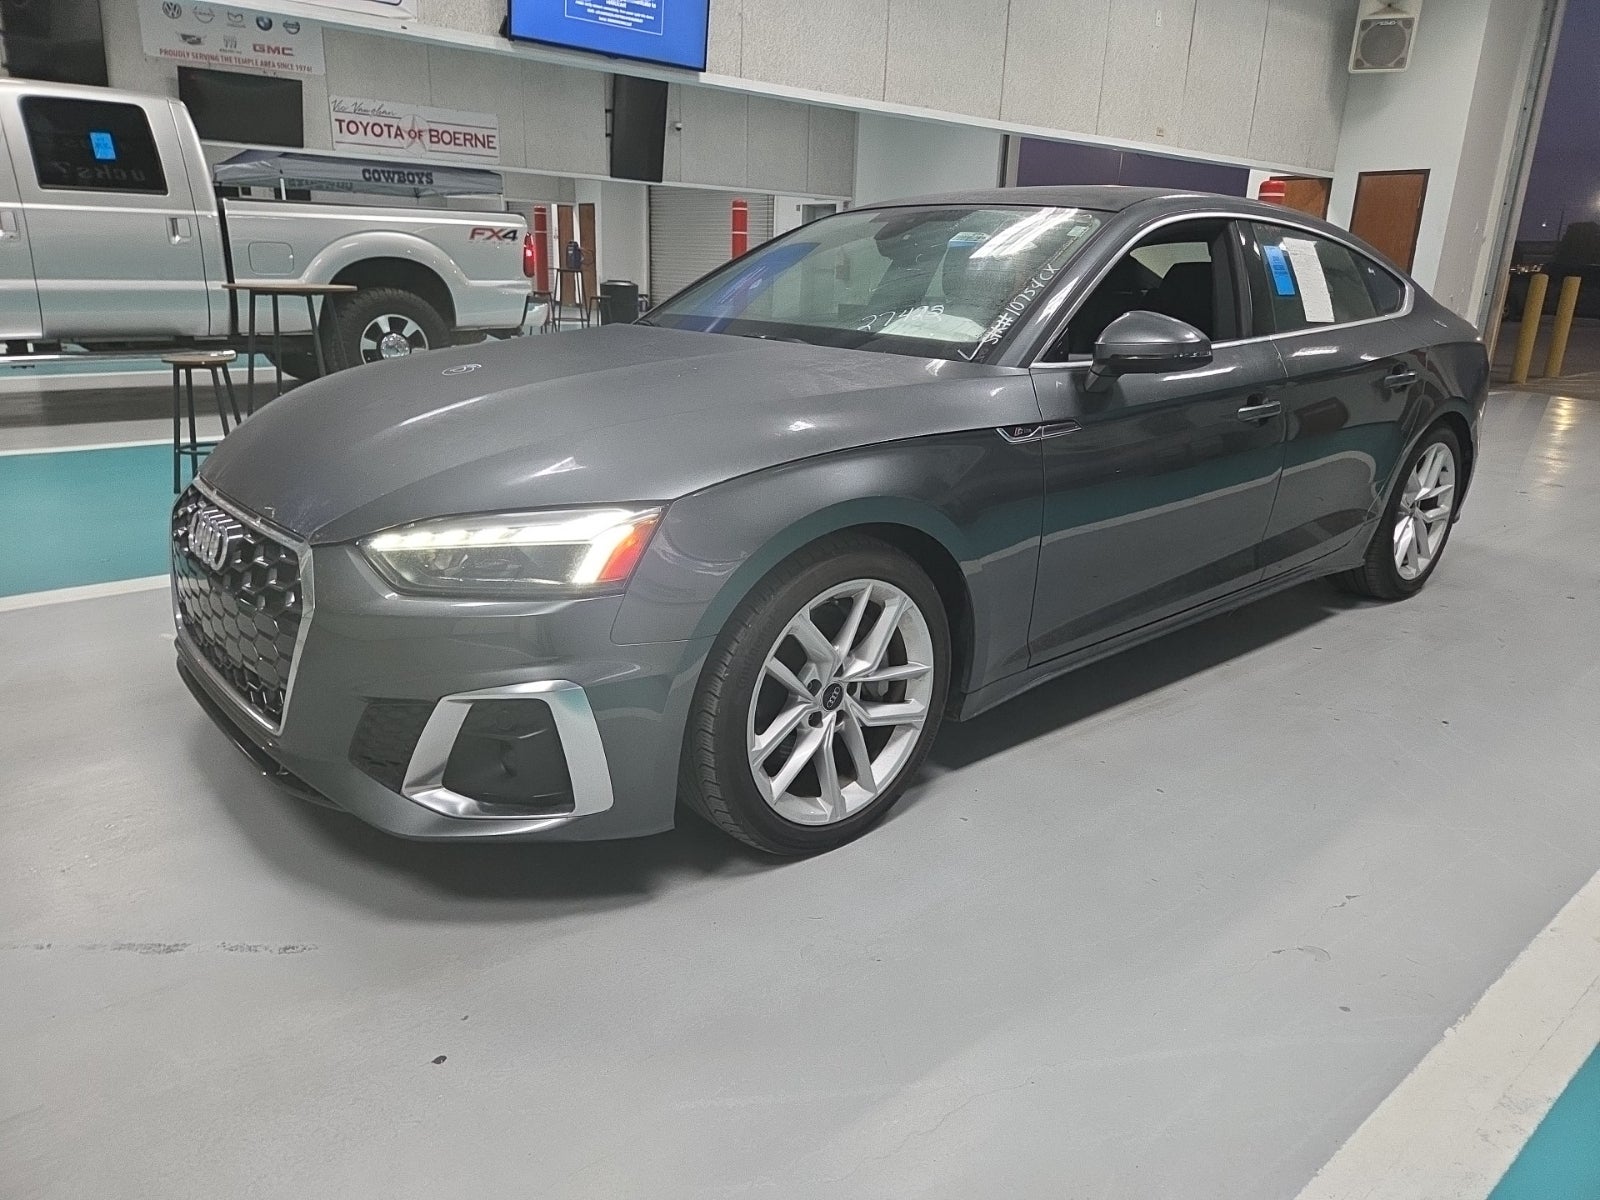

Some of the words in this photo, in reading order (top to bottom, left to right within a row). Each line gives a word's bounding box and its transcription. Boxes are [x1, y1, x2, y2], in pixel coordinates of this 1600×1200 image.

[252, 43, 294, 57] GMC
[159, 48, 190, 59] PROUDLY
[192, 51, 220, 63] SERVING
[220, 55, 232, 64] THE
[233, 56, 259, 67] TEMPLE
[259, 60, 276, 69] AREA
[276, 62, 294, 71] SINCE
[334, 118, 405, 140] TOYOTA
[407, 128, 424, 140] OF
[428, 128, 497, 149] BOERNE
[361, 168, 434, 185] COWBOYS
[469, 227, 518, 242] FX4
